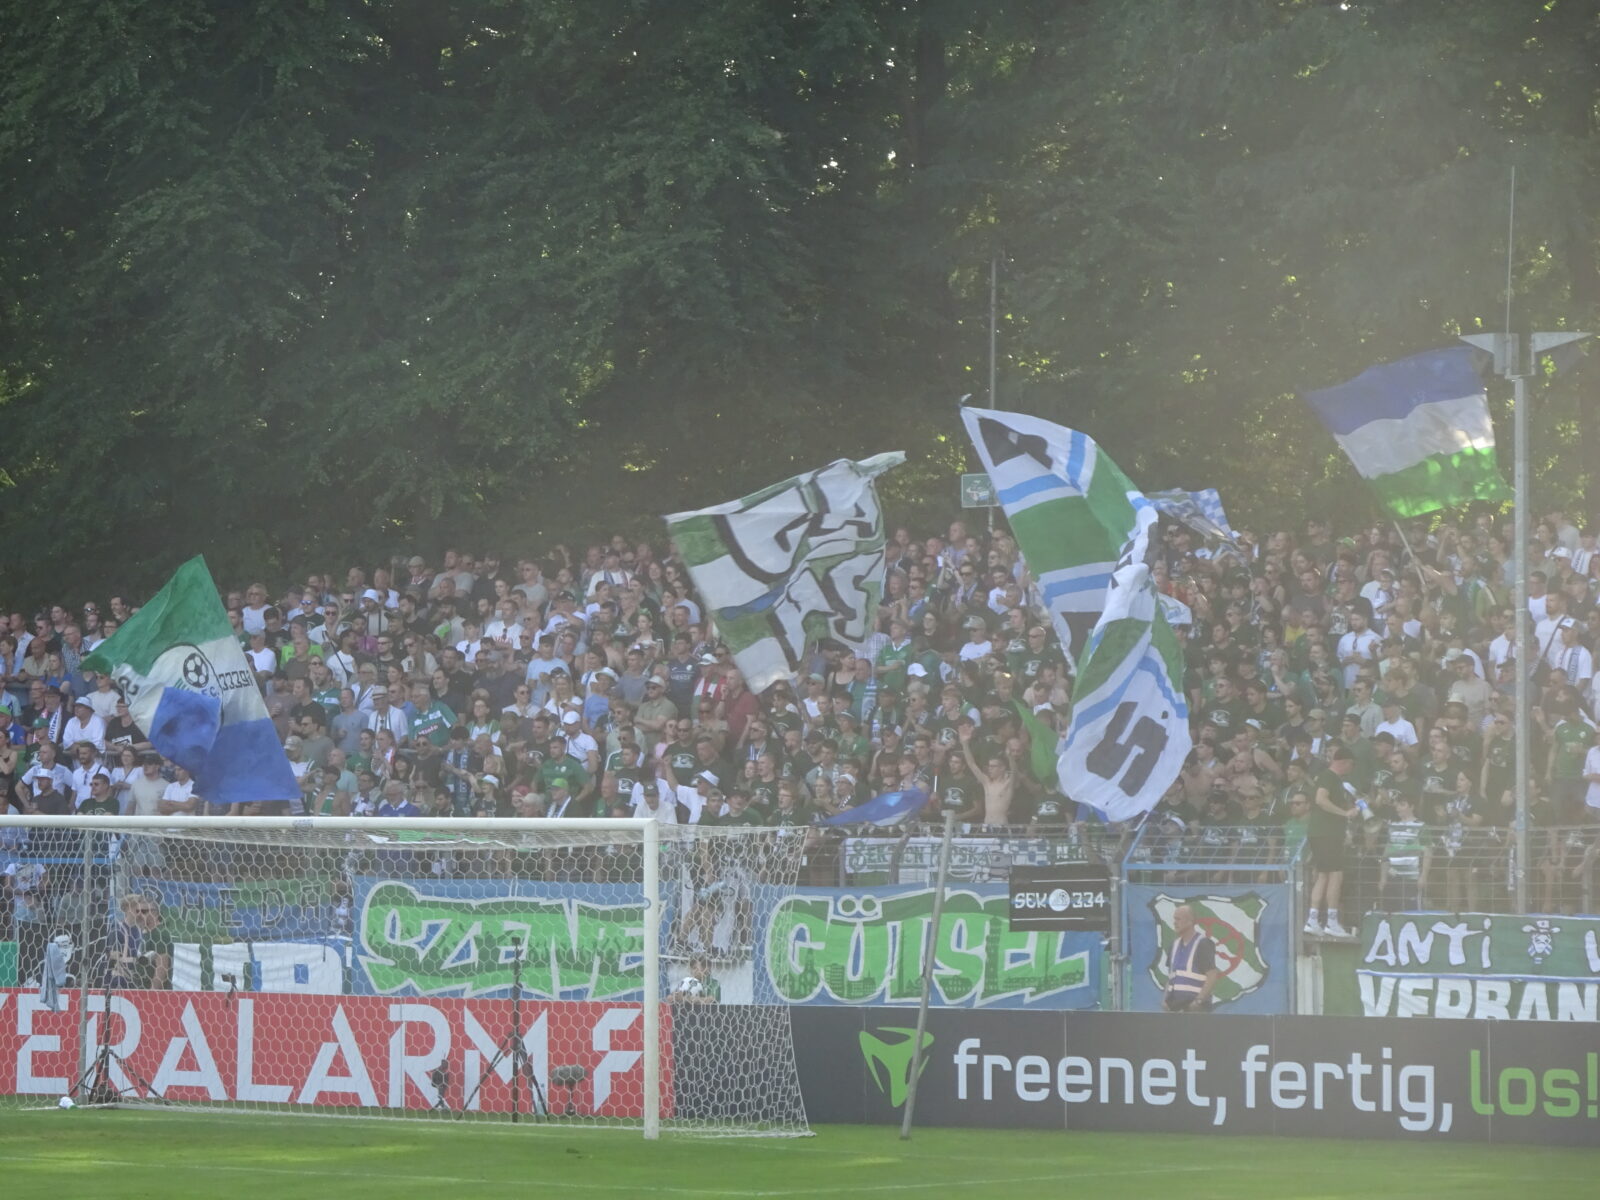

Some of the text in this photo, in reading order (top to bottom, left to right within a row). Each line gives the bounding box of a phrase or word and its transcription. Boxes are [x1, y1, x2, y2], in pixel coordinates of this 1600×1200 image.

[358, 880, 667, 999] SZENE
[1014, 891, 1105, 909] SEK 334
[953, 1038, 1598, 1132] freenet, fertig, los!
